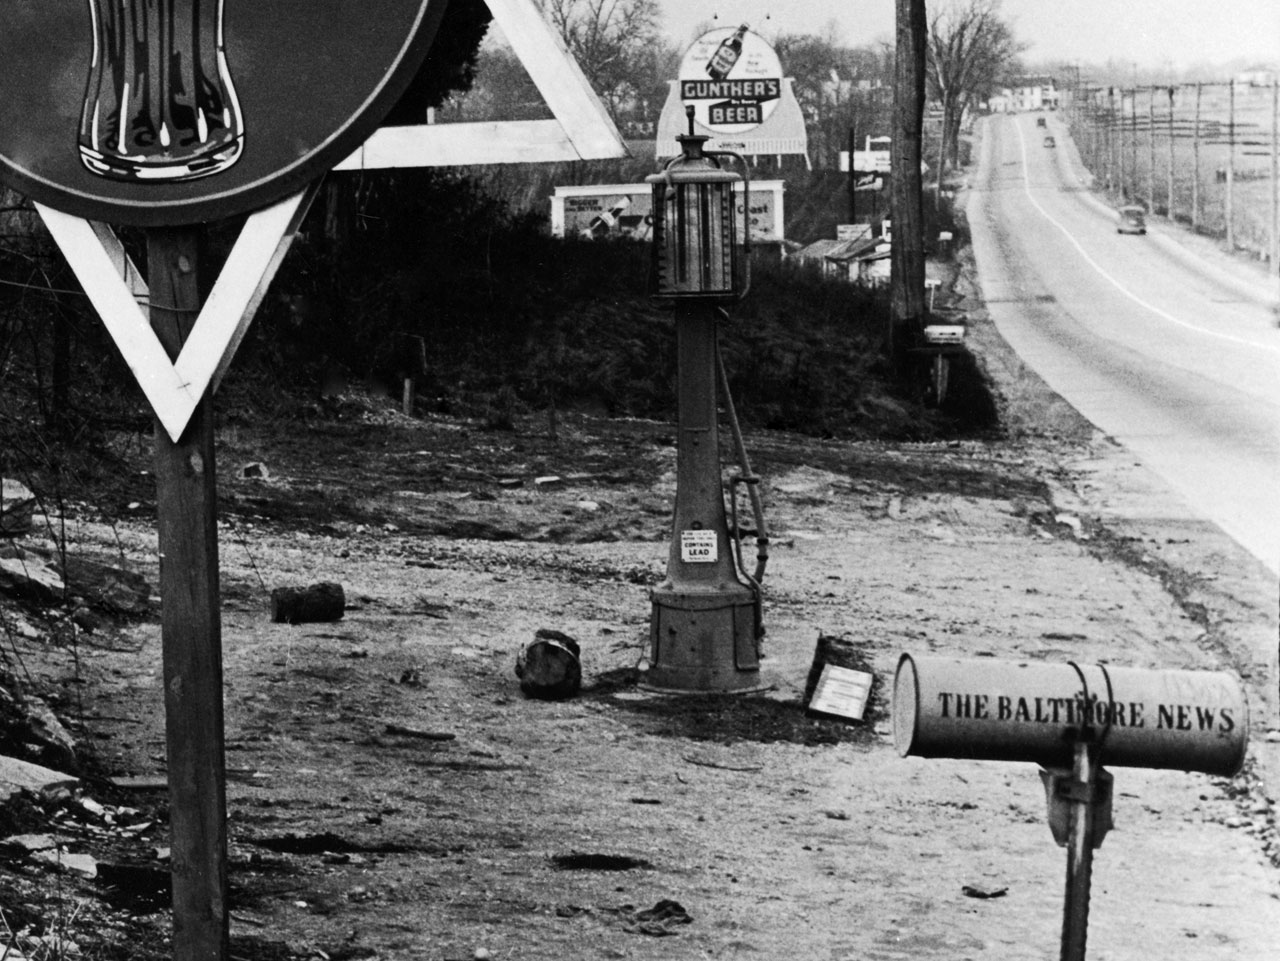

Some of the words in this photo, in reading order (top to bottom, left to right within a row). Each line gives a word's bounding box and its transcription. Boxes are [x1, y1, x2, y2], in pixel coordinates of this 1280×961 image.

[684, 80, 778, 97] GUNTHER'S
[712, 106, 758, 123] BEER
[689, 548, 710, 556] LEAD
[937, 691, 989, 719] THE
[1156, 703, 1235, 732] NEWS
